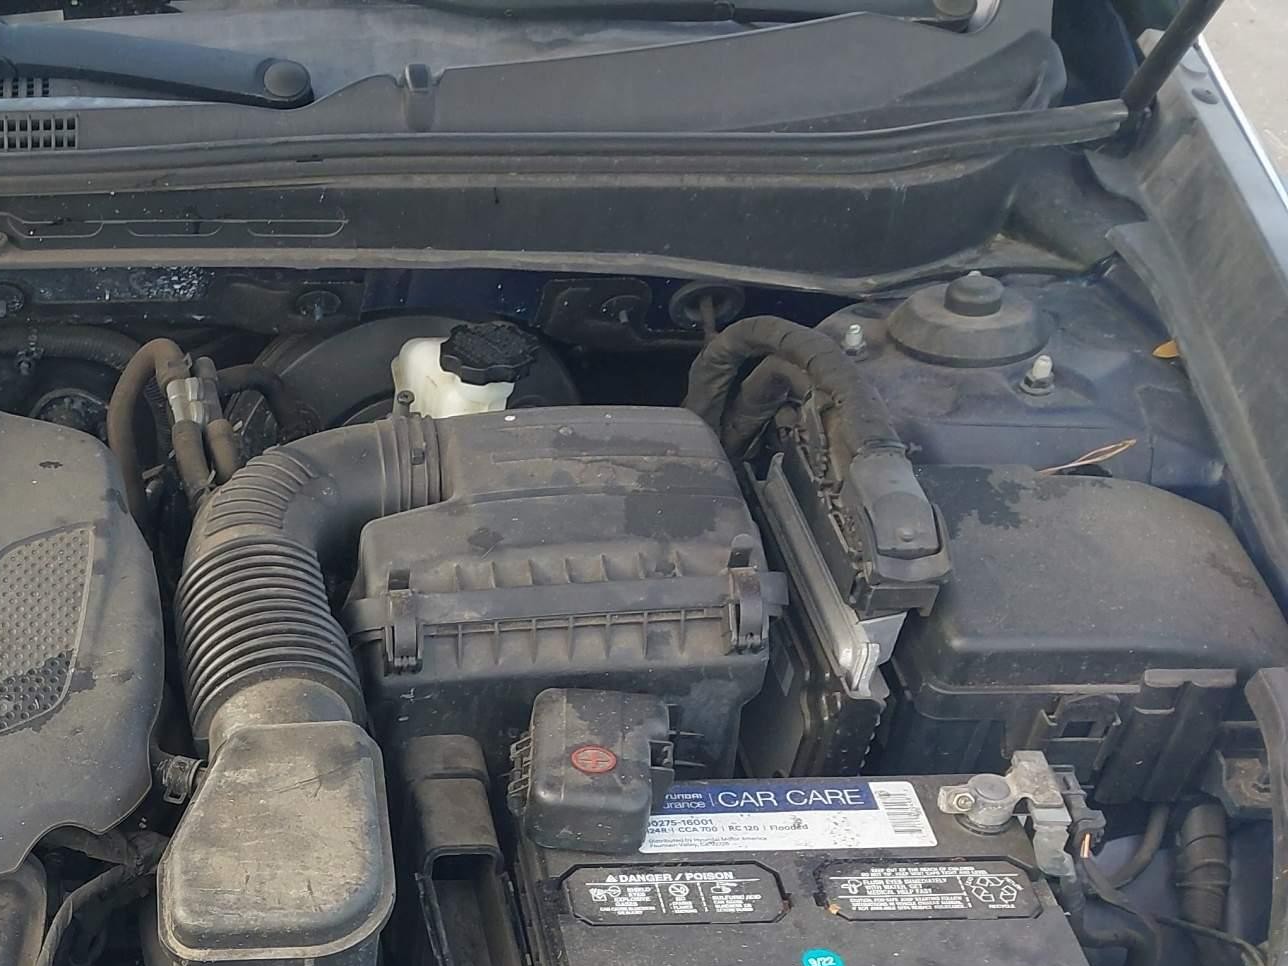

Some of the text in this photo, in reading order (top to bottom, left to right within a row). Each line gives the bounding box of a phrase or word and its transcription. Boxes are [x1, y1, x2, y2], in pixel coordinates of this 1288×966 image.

[718, 788, 864, 808] CAR CARE
[700, 825, 718, 833] 700
[770, 823, 808, 831] Flooded
[619, 873, 673, 882] DANGER
[685, 871, 734, 881] POISON
